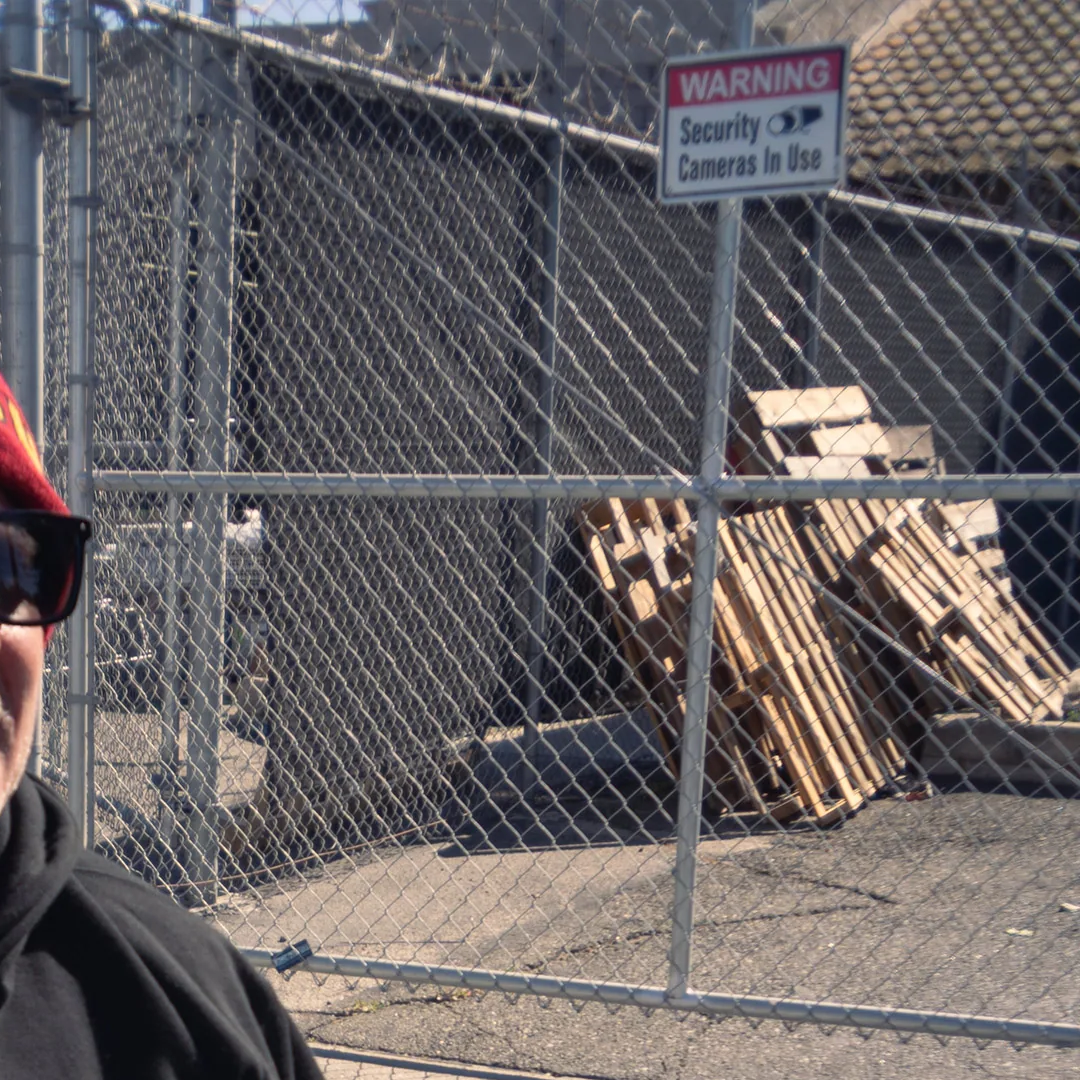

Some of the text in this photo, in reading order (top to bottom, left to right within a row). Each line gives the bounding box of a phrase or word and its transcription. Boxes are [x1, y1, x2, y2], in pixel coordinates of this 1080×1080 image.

[679, 58, 829, 103] WARNING
[680, 111, 760, 146] Security
[678, 142, 822, 182] Cameras In Use
